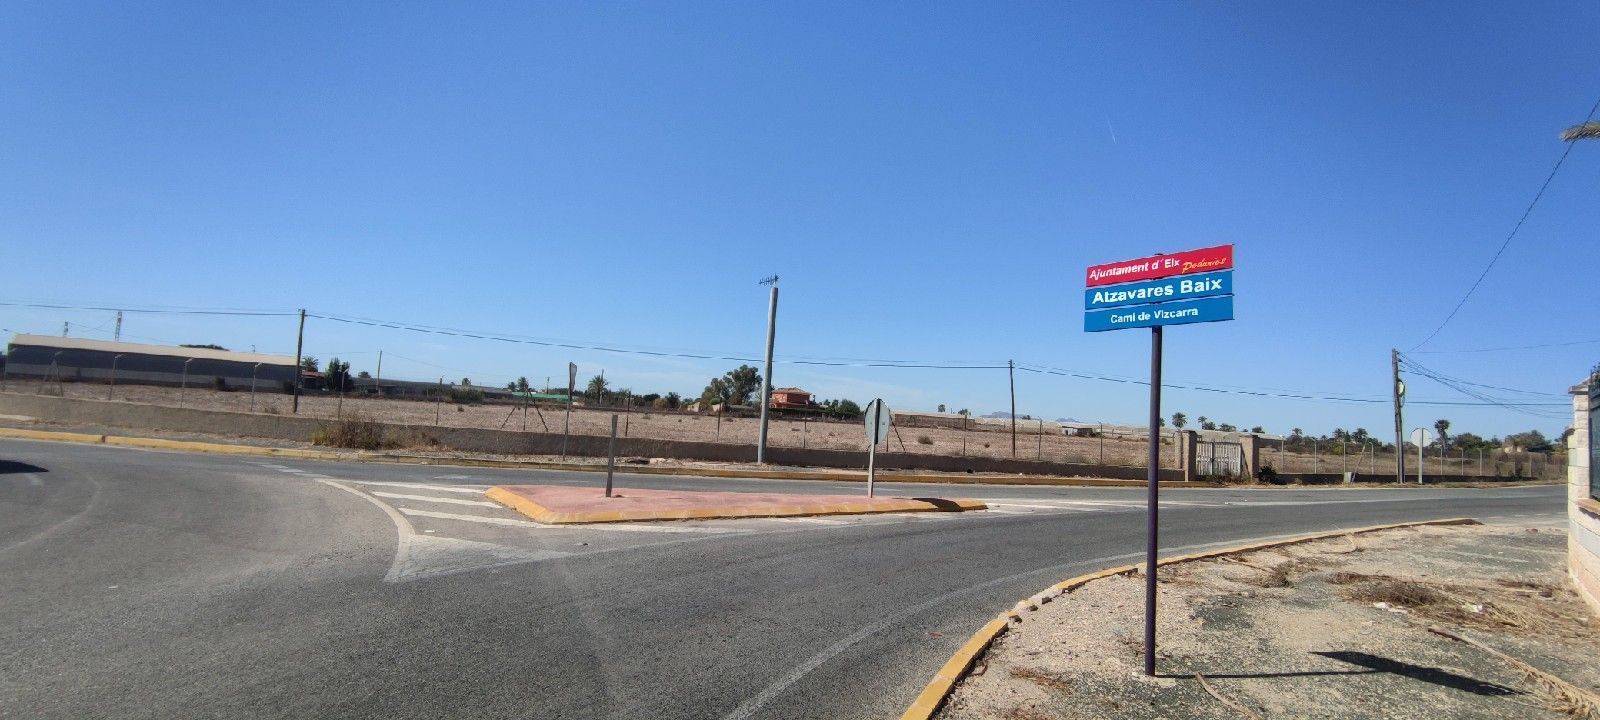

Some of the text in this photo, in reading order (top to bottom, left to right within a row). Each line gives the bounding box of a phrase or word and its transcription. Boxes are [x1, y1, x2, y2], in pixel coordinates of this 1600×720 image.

[1089, 263, 1149, 281] Ajuntament
[1092, 278, 1222, 304] Atzavares Baix
[1137, 312, 1151, 321] de
[1153, 308, 1199, 320] Vizcarra
